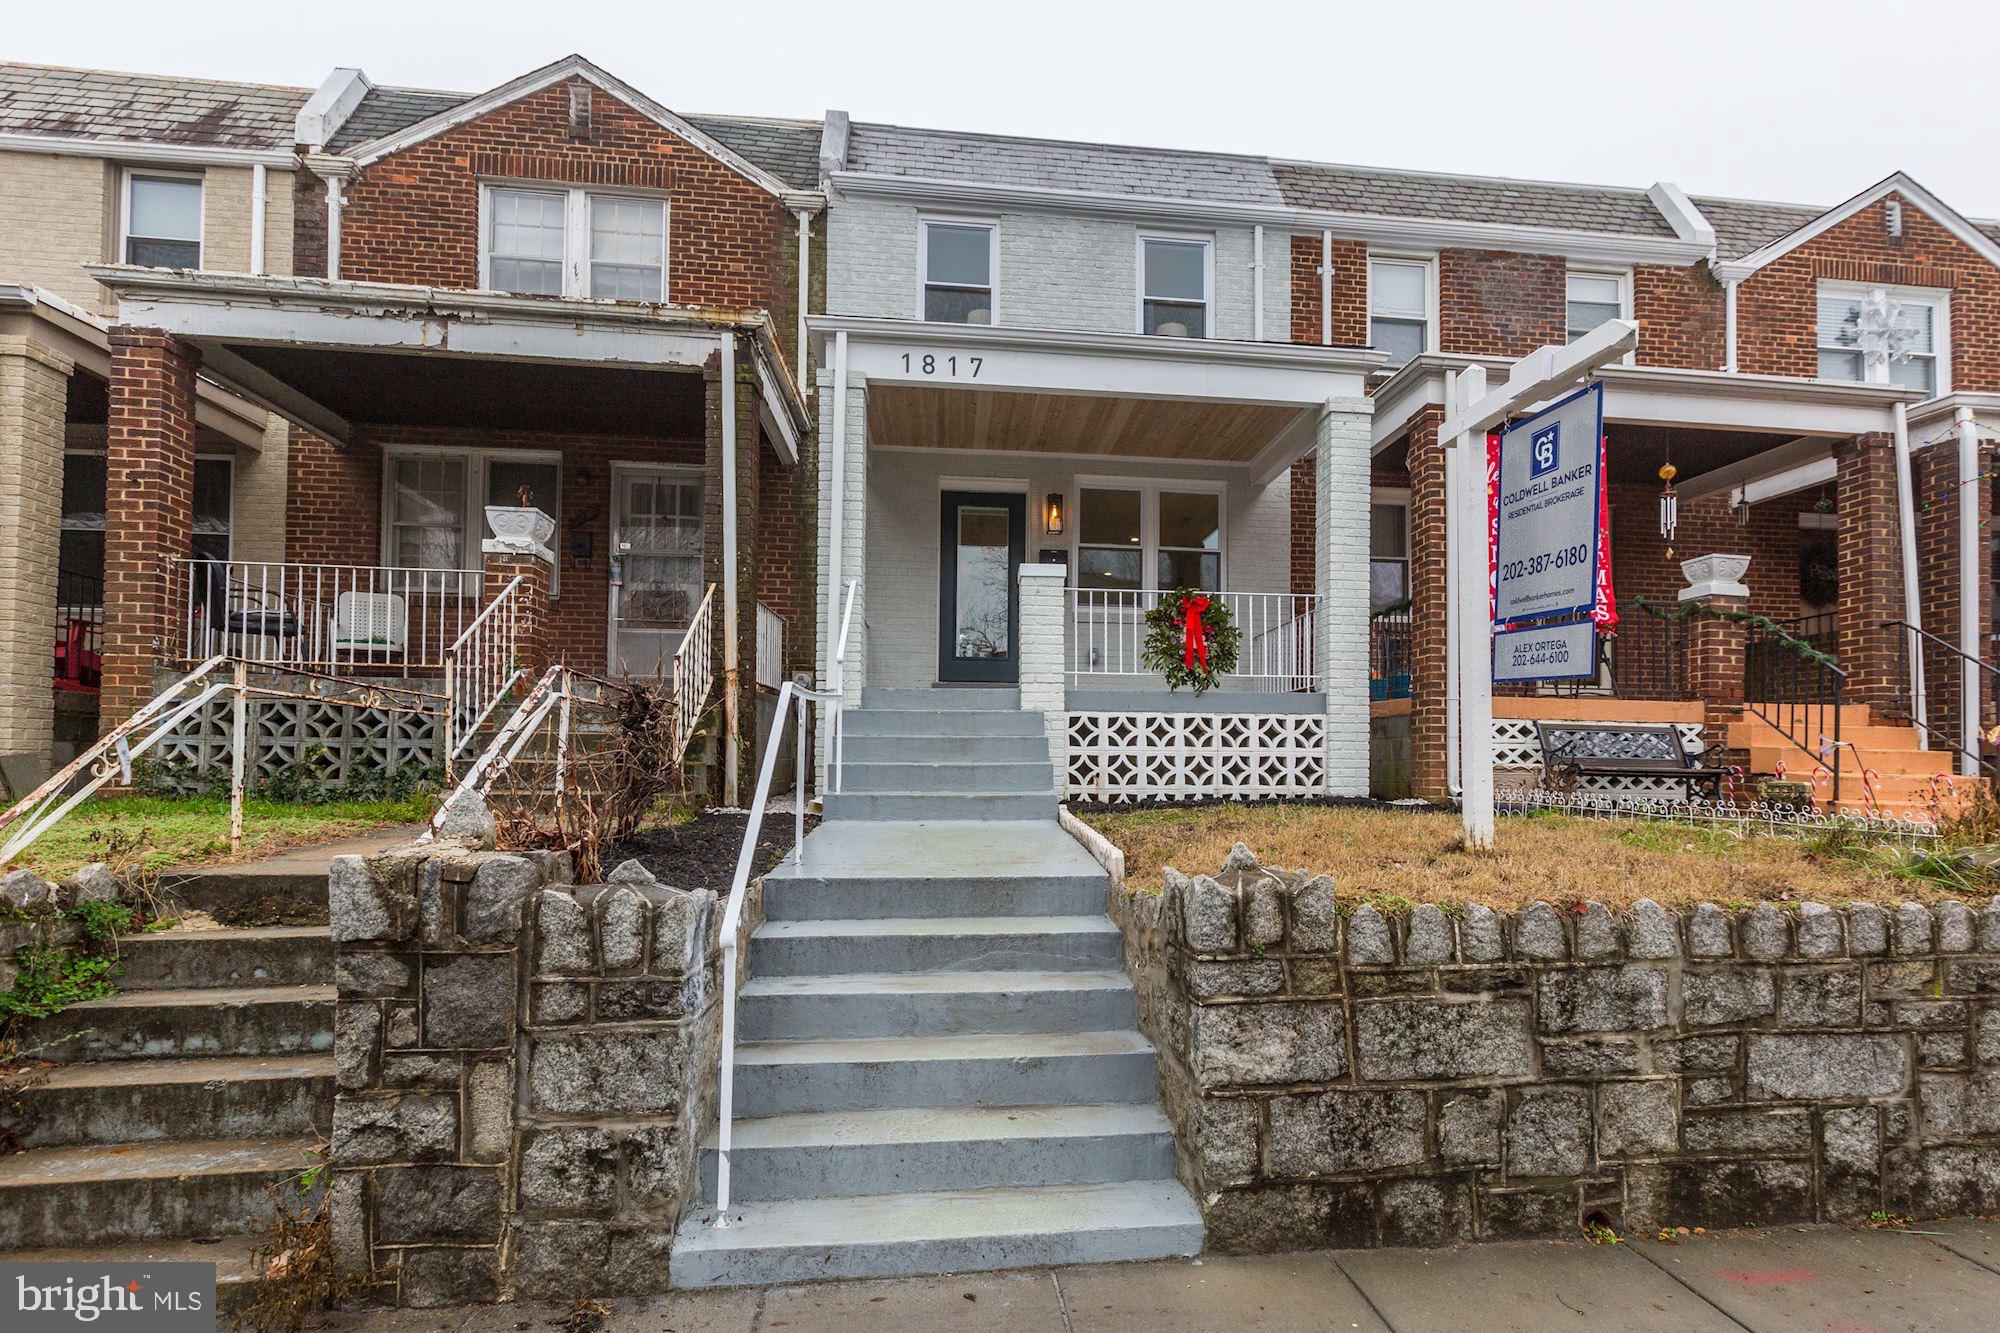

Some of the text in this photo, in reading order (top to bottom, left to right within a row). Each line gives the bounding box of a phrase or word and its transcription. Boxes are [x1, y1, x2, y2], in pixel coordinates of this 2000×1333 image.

[902, 353, 983, 378] 1817
[1503, 481, 1549, 506] COLDWELL
[1551, 463, 1593, 489] BANKER
[1507, 502, 1544, 520] RESIDENTIAL
[1544, 486, 1585, 509] BROKERAGE
[1502, 544, 1588, 581] 202-387-6180
[1509, 587, 1575, 605] coldwellbankerhomes.com
[1512, 651, 1569, 667] 202-644-6100
[1514, 640, 1568, 654] ALEX ORTEGA
